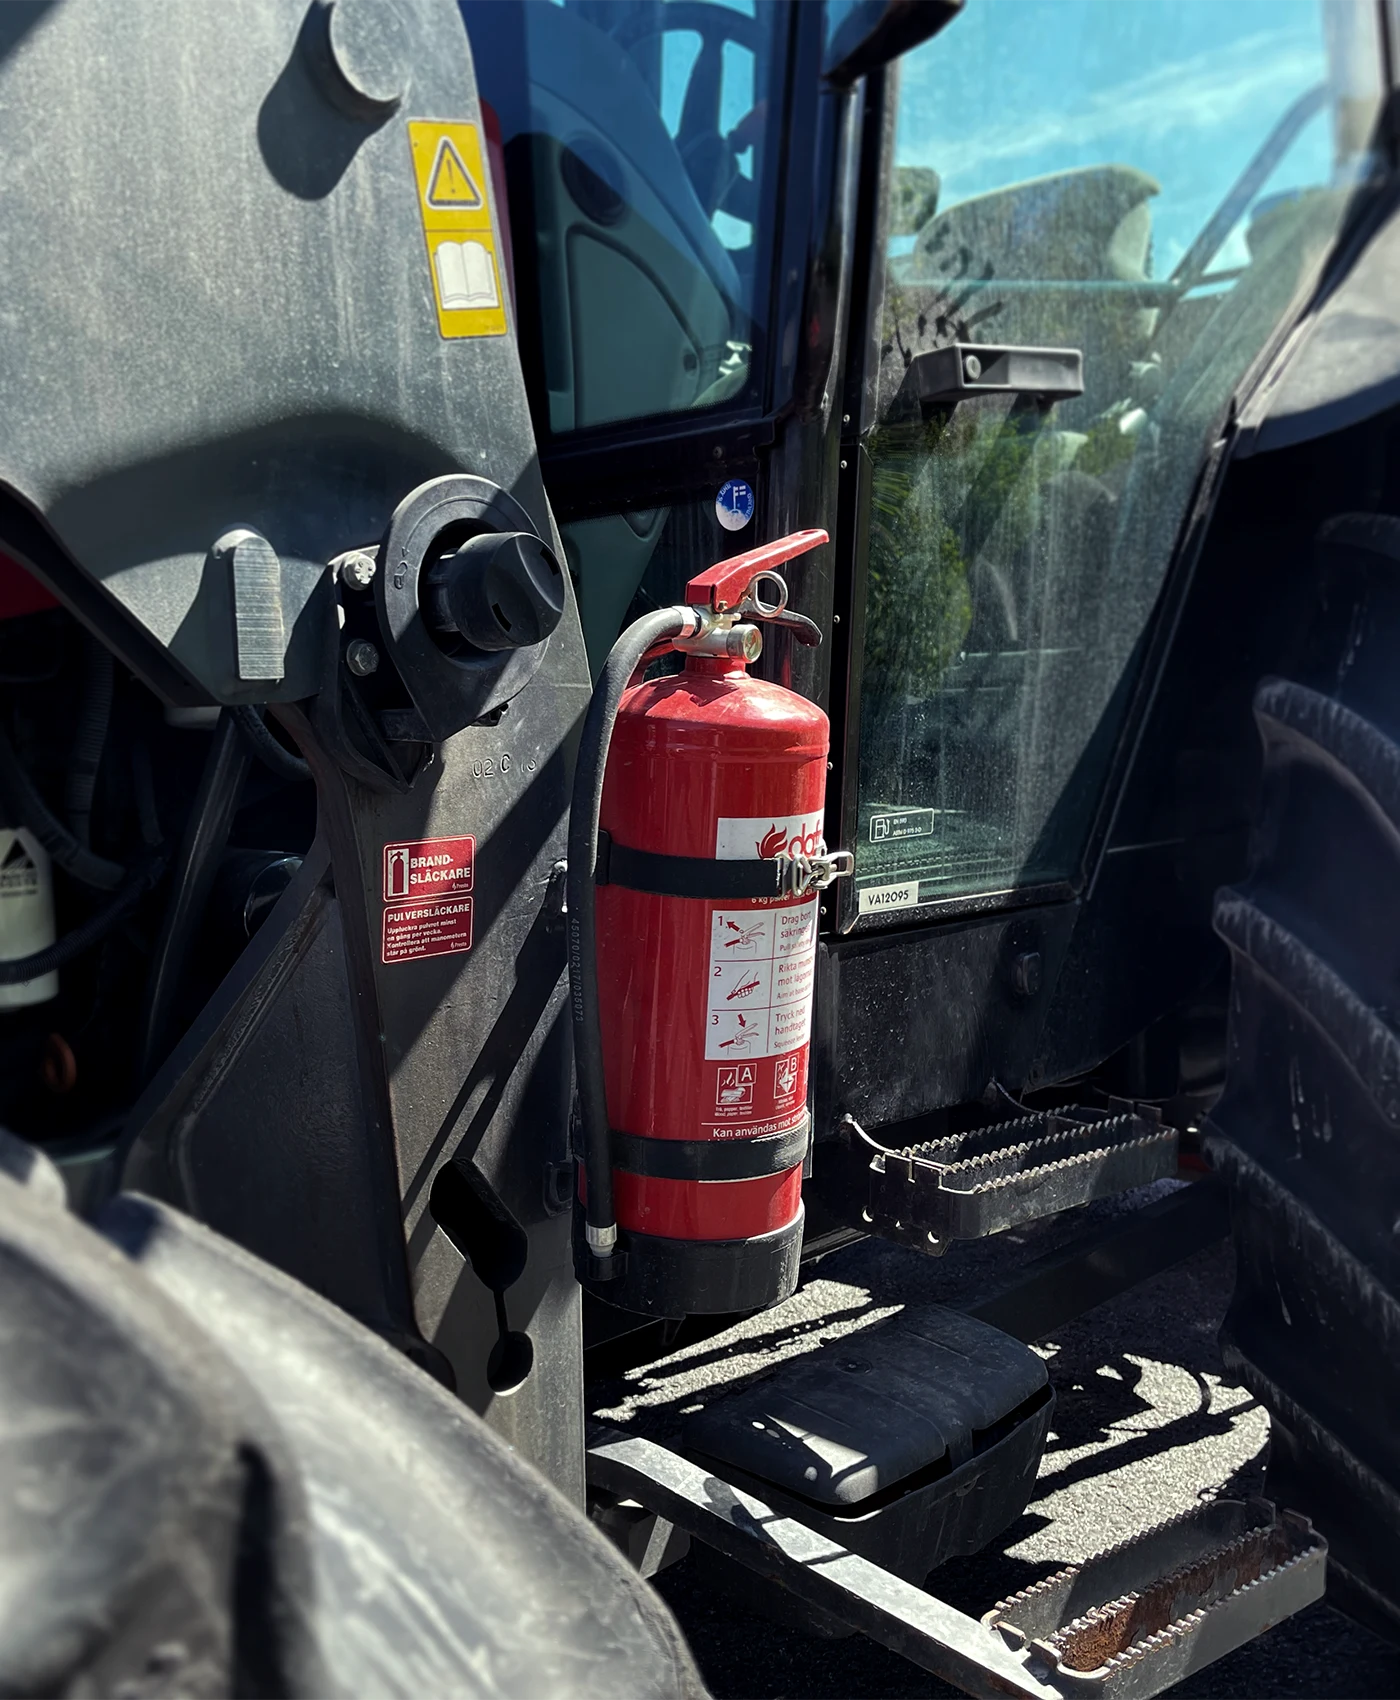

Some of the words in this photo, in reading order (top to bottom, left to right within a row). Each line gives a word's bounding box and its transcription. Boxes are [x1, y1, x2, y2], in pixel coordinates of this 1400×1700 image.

[472, 758, 494, 778] 02
[500, 753, 511, 773] C
[410, 855, 454, 868] BRAND-
[410, 868, 471, 884] SLÄCKARE
[868, 890, 909, 906] VA12095
[387, 904, 470, 922] PULVERSLÄCKARE
[782, 916, 799, 926] Drag
[571, 918, 583, 1022] 45070/0217/035073
[714, 966, 722, 976] 2
[778, 963, 797, 973] Rikta
[778, 976, 793, 986] mot
[712, 1014, 719, 1024] 3
[775, 1010, 794, 1022] Tryck
[774, 1018, 806, 1035] handtaget
[790, 1057, 798, 1071] B
[741, 1067, 752, 1082] A
[713, 1128, 732, 1138] Kan
[734, 1123, 778, 1137] användas
[778, 1120, 791, 1130] mot
